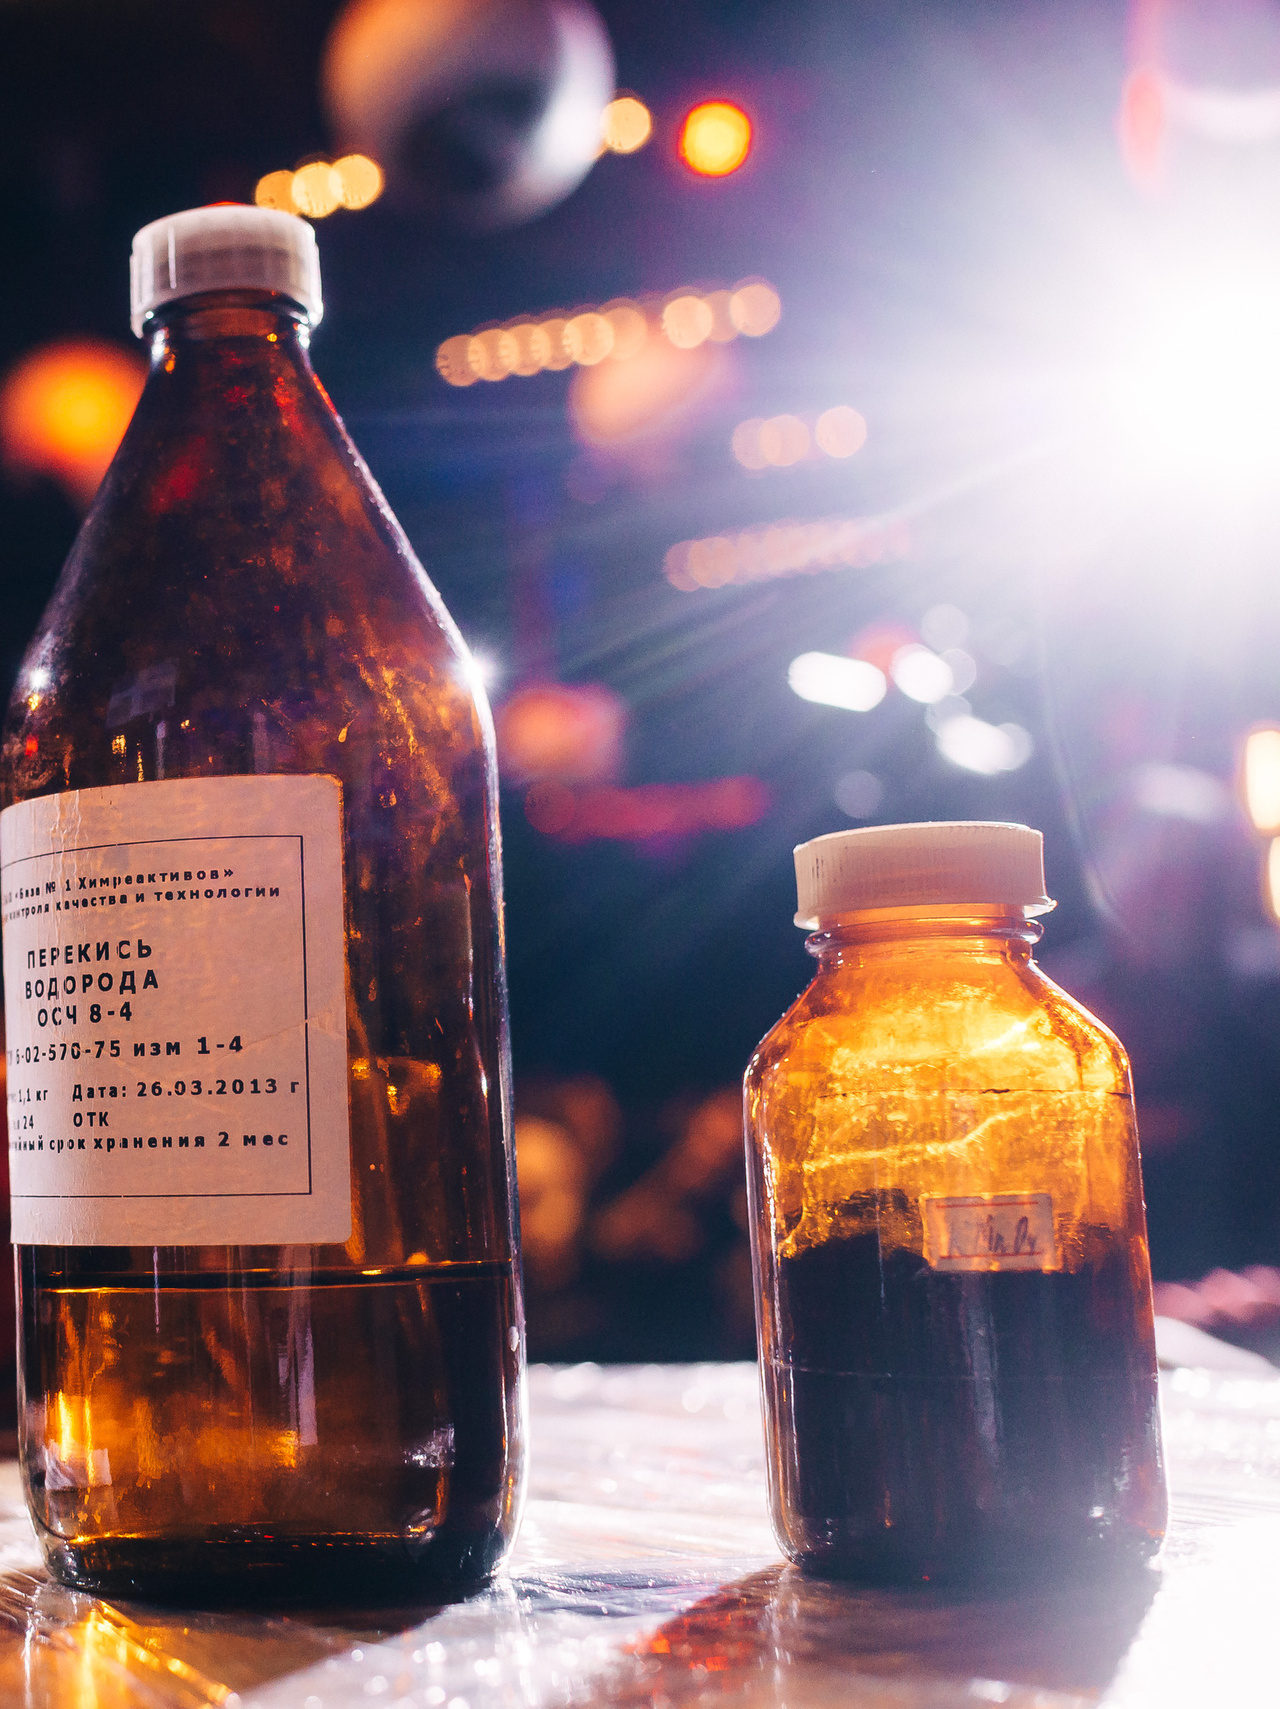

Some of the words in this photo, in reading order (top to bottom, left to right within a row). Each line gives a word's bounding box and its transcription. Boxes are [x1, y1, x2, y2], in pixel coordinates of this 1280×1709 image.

[45, 881, 56, 894] №
[65, 879, 71, 891] 1
[78, 869, 234, 889] Химреактивов»
[56, 894, 127, 911] качества
[135, 893, 145, 902] и
[154, 887, 280, 901] технологии
[27, 939, 152, 969] ПЕРЕКИСЬ
[25, 969, 158, 1000] ВОДОРОДА
[37, 1005, 77, 1027] ОСЧ
[89, 1001, 132, 1023] 8-4
[133, 1042, 181, 1056] изм
[197, 1035, 243, 1054] 1-4
[36, 1090, 48, 1101] кг
[72, 1084, 126, 1102] Дата:
[136, 1078, 277, 1097] 26.03.2013
[290, 1081, 300, 1093] г
[72, 1112, 109, 1127] ОТК
[49, 1139, 86, 1153] срок
[93, 1135, 205, 1153] хранения
[218, 1131, 230, 1147] 2
[243, 1134, 288, 1146] мес
